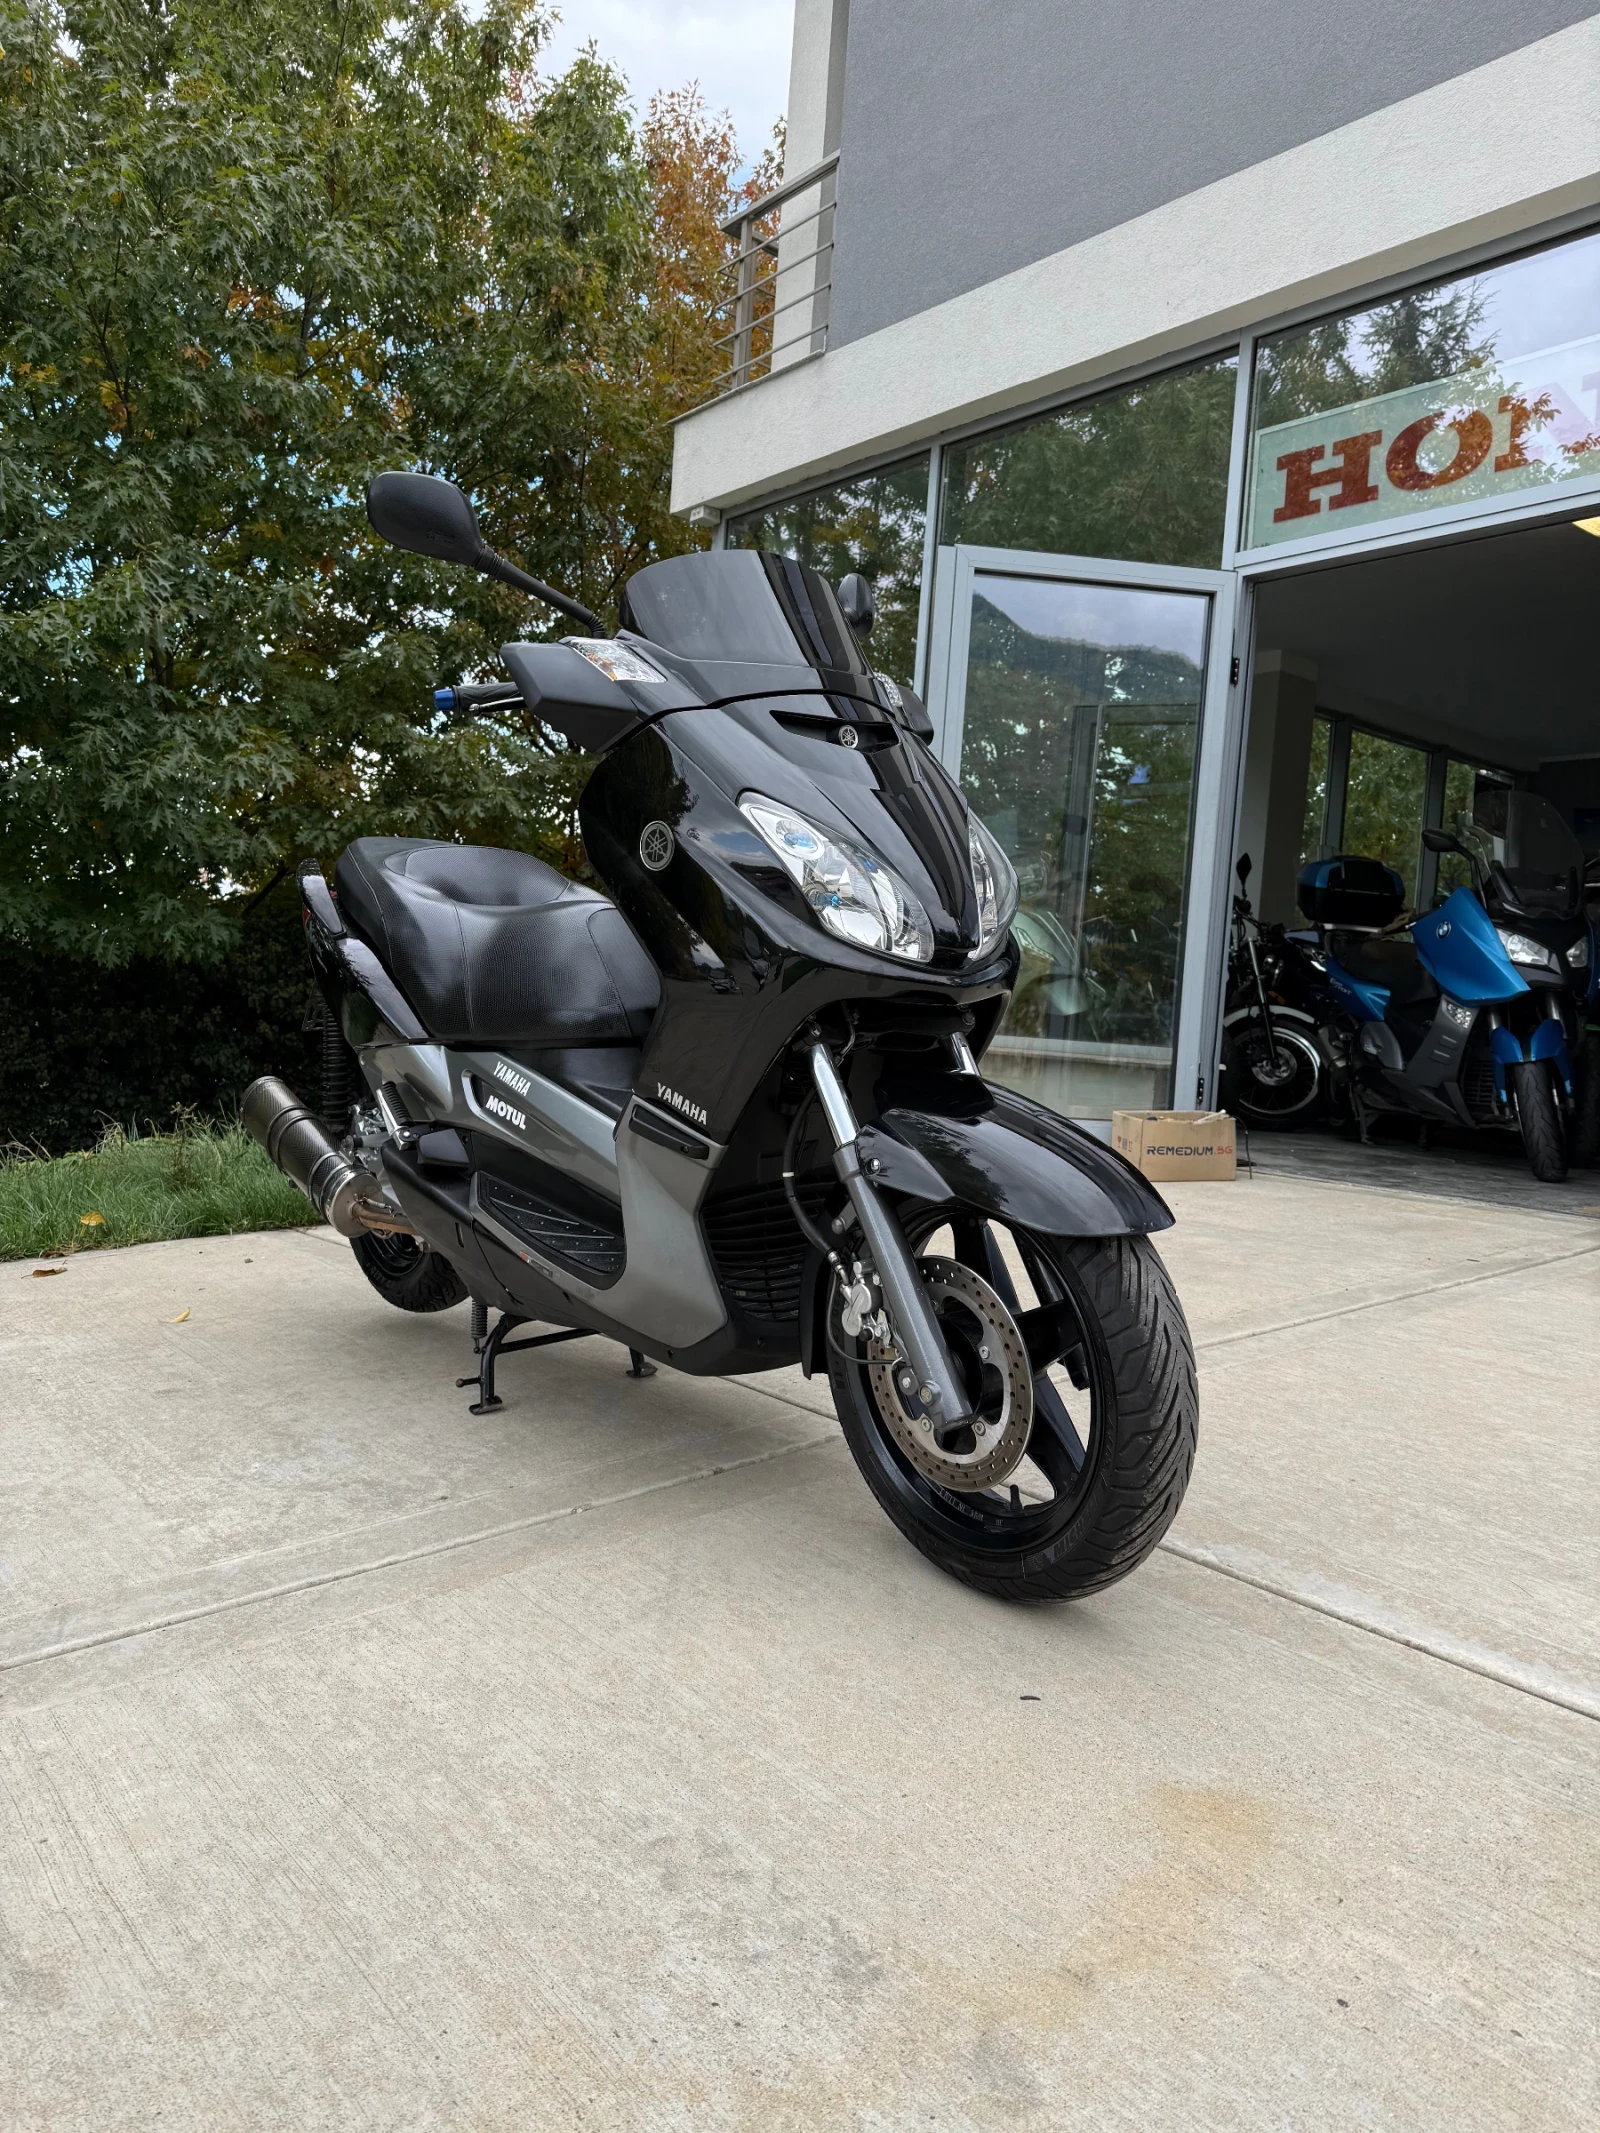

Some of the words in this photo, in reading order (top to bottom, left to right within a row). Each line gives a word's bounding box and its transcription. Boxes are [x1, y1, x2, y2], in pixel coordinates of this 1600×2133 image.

[492, 1060, 532, 1097] YAMAHA
[485, 1094, 527, 1131] MOTUL
[656, 1082, 708, 1126] YAMAHA
[1146, 1145, 1233, 1156] REMEDIUM.BG
